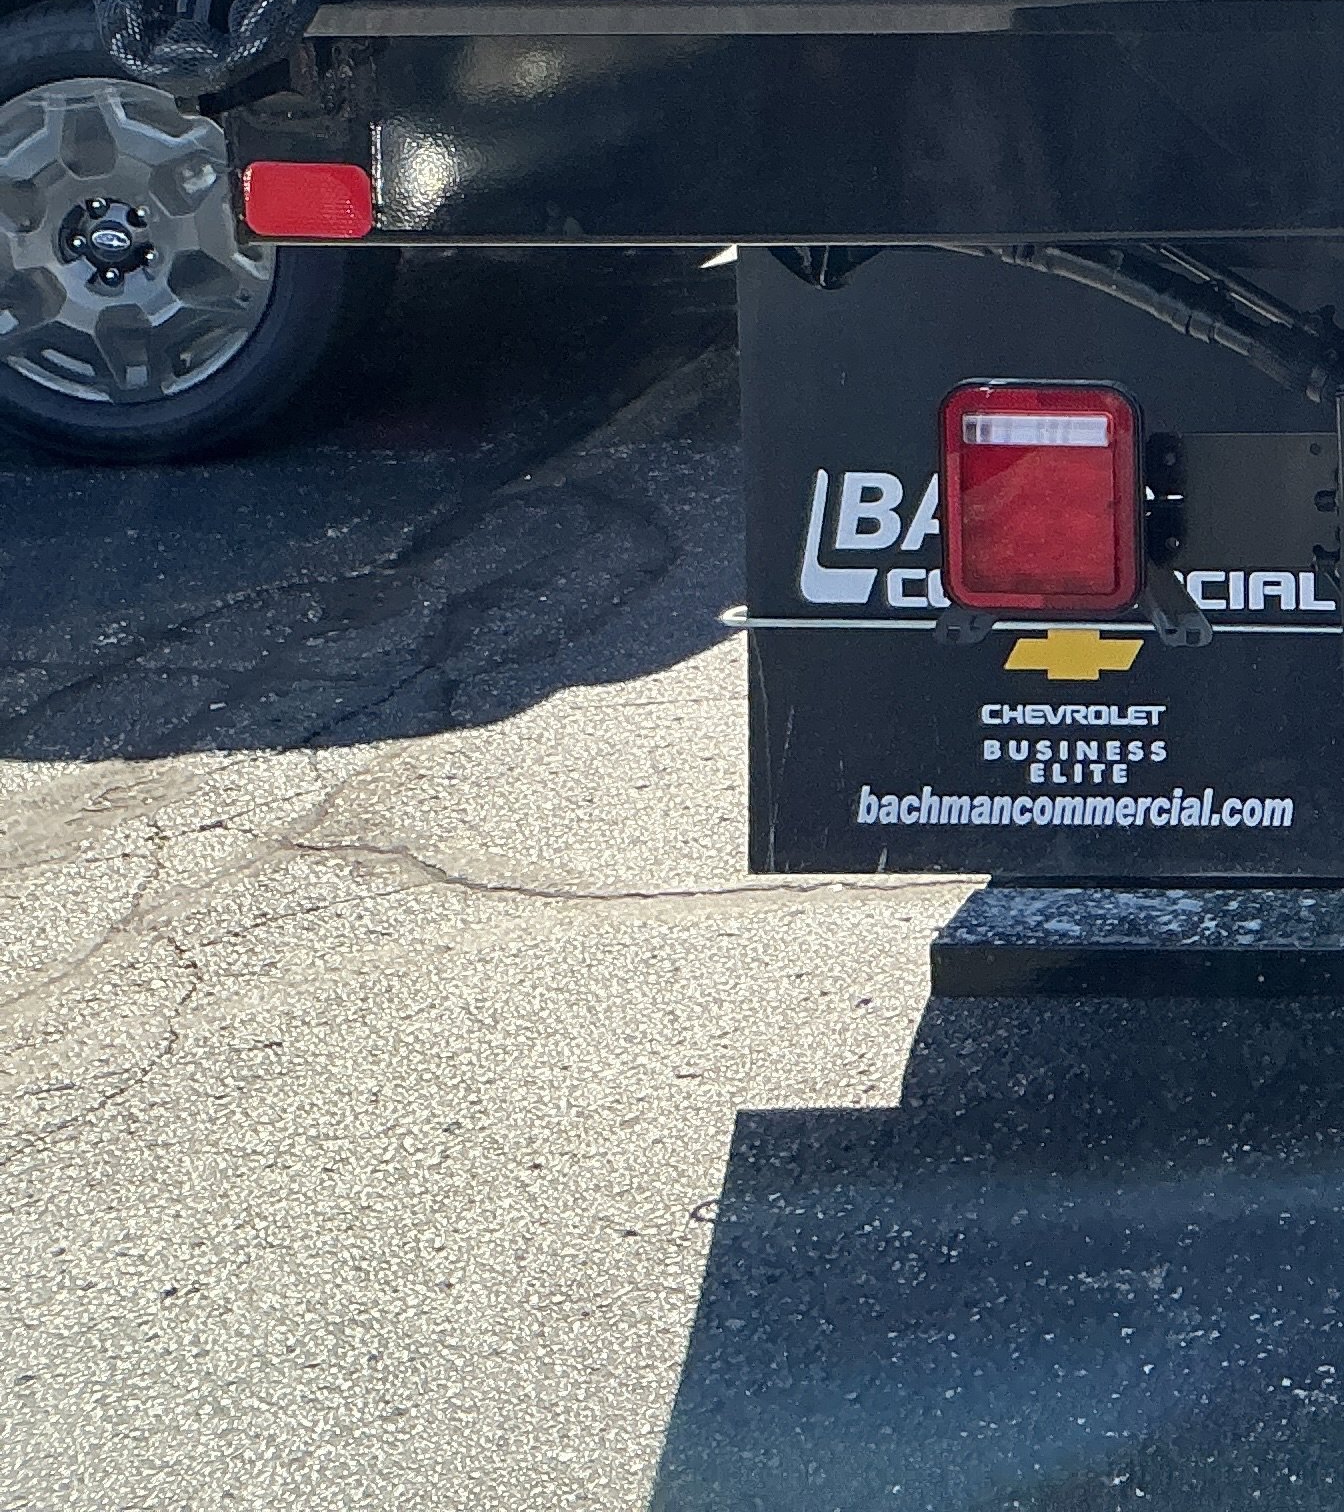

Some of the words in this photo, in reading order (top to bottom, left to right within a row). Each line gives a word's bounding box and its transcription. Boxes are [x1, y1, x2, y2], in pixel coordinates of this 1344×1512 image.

[887, 568, 1337, 610] CCIAL
[981, 704, 1166, 726] CHEVROLET
[983, 740, 1168, 762] BUSINESS
[1030, 764, 1128, 784] ELITE
[856, 786, 1295, 828] bachmancommercial.com
